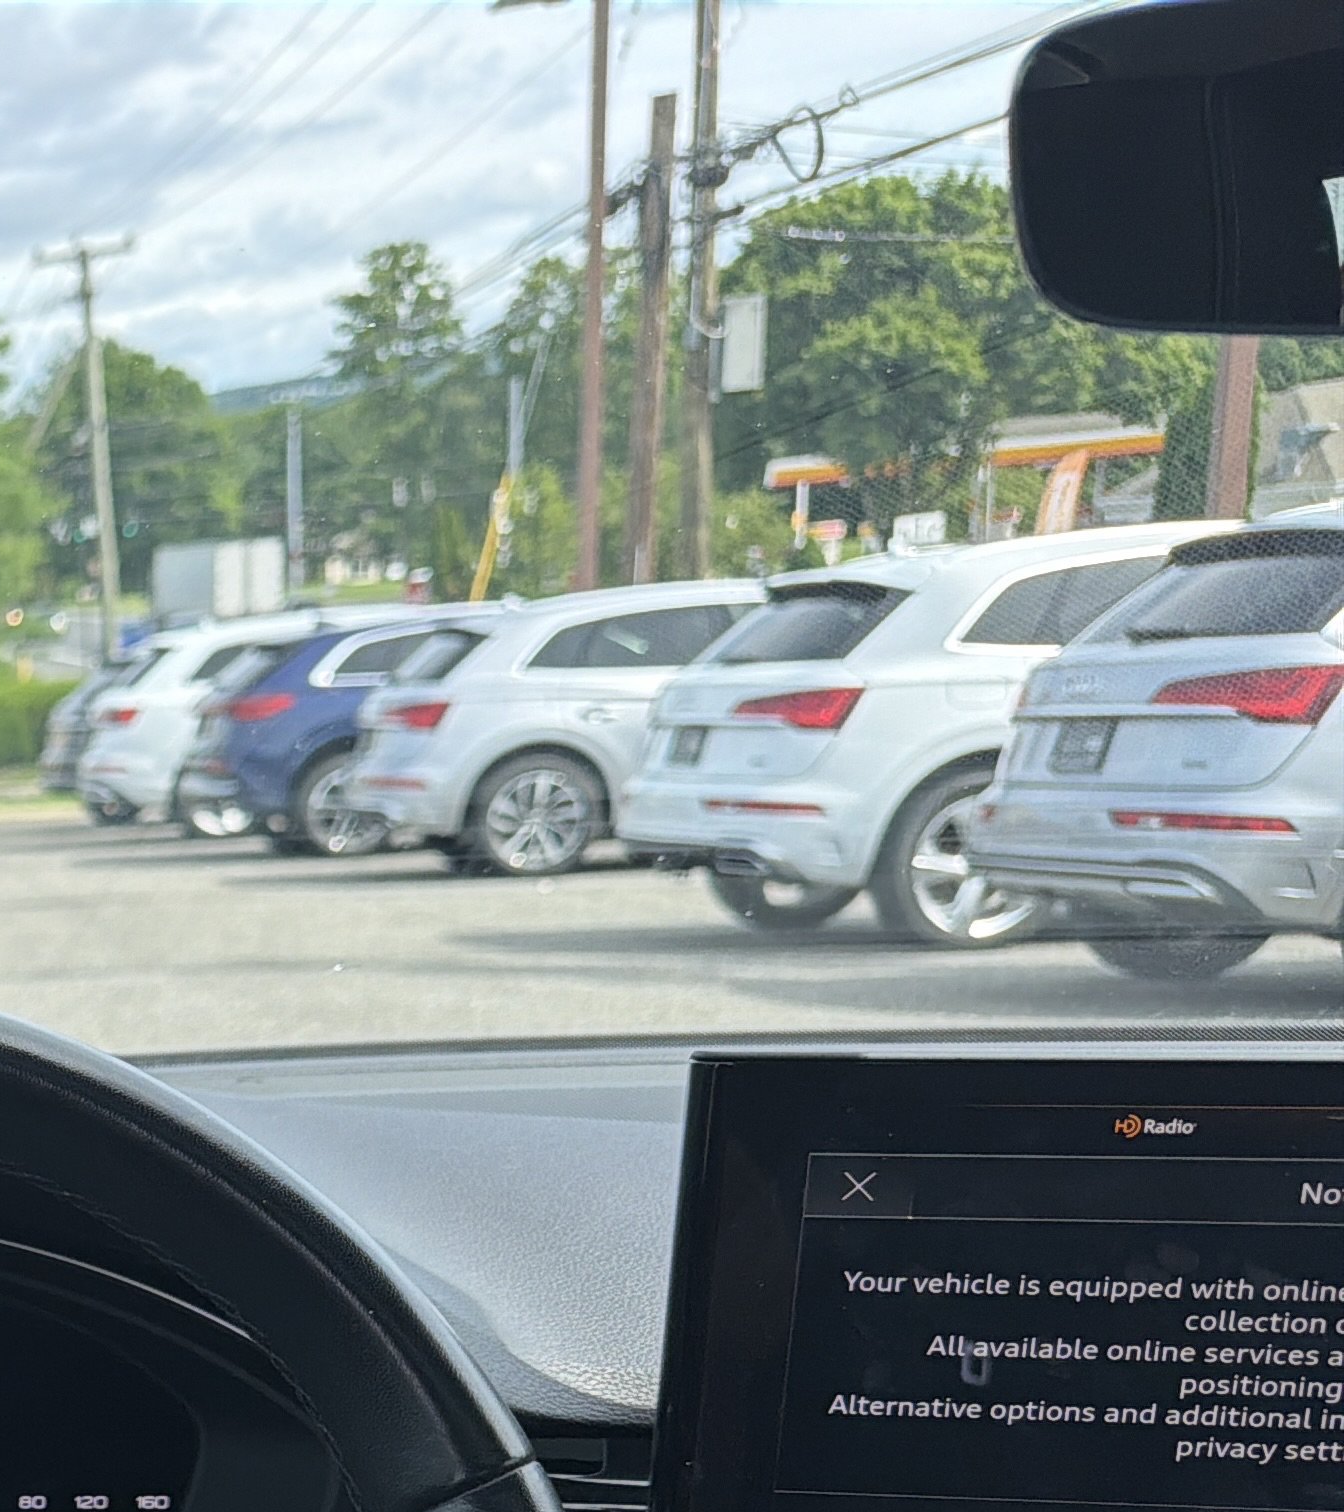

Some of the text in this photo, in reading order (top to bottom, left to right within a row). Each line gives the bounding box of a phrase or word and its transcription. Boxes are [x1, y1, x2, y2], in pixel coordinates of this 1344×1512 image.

[1144, 1118, 1194, 1134] Radio
[1300, 1182, 1344, 1205] No
[844, 1271, 907, 1296] Your
[913, 1272, 1010, 1296] vehicle
[1020, 1275, 1039, 1296] is
[1049, 1276, 1181, 1303] equipped
[1191, 1278, 1254, 1300] with
[1185, 1310, 1326, 1334] collection
[927, 1336, 966, 1357] All
[973, 1338, 1098, 1361] available
[1106, 1340, 1195, 1363] online
[1204, 1344, 1319, 1366] services
[1179, 1374, 1343, 1404] positioning
[828, 1394, 982, 1418] Alternative
[990, 1399, 1095, 1426] options
[1104, 1402, 1156, 1424] and
[1165, 1404, 1312, 1430] additional
[1175, 1437, 1277, 1464] privacy
[18, 1495, 47, 1510] 80
[75, 1495, 108, 1510] 120
[137, 1495, 170, 1510] 160
